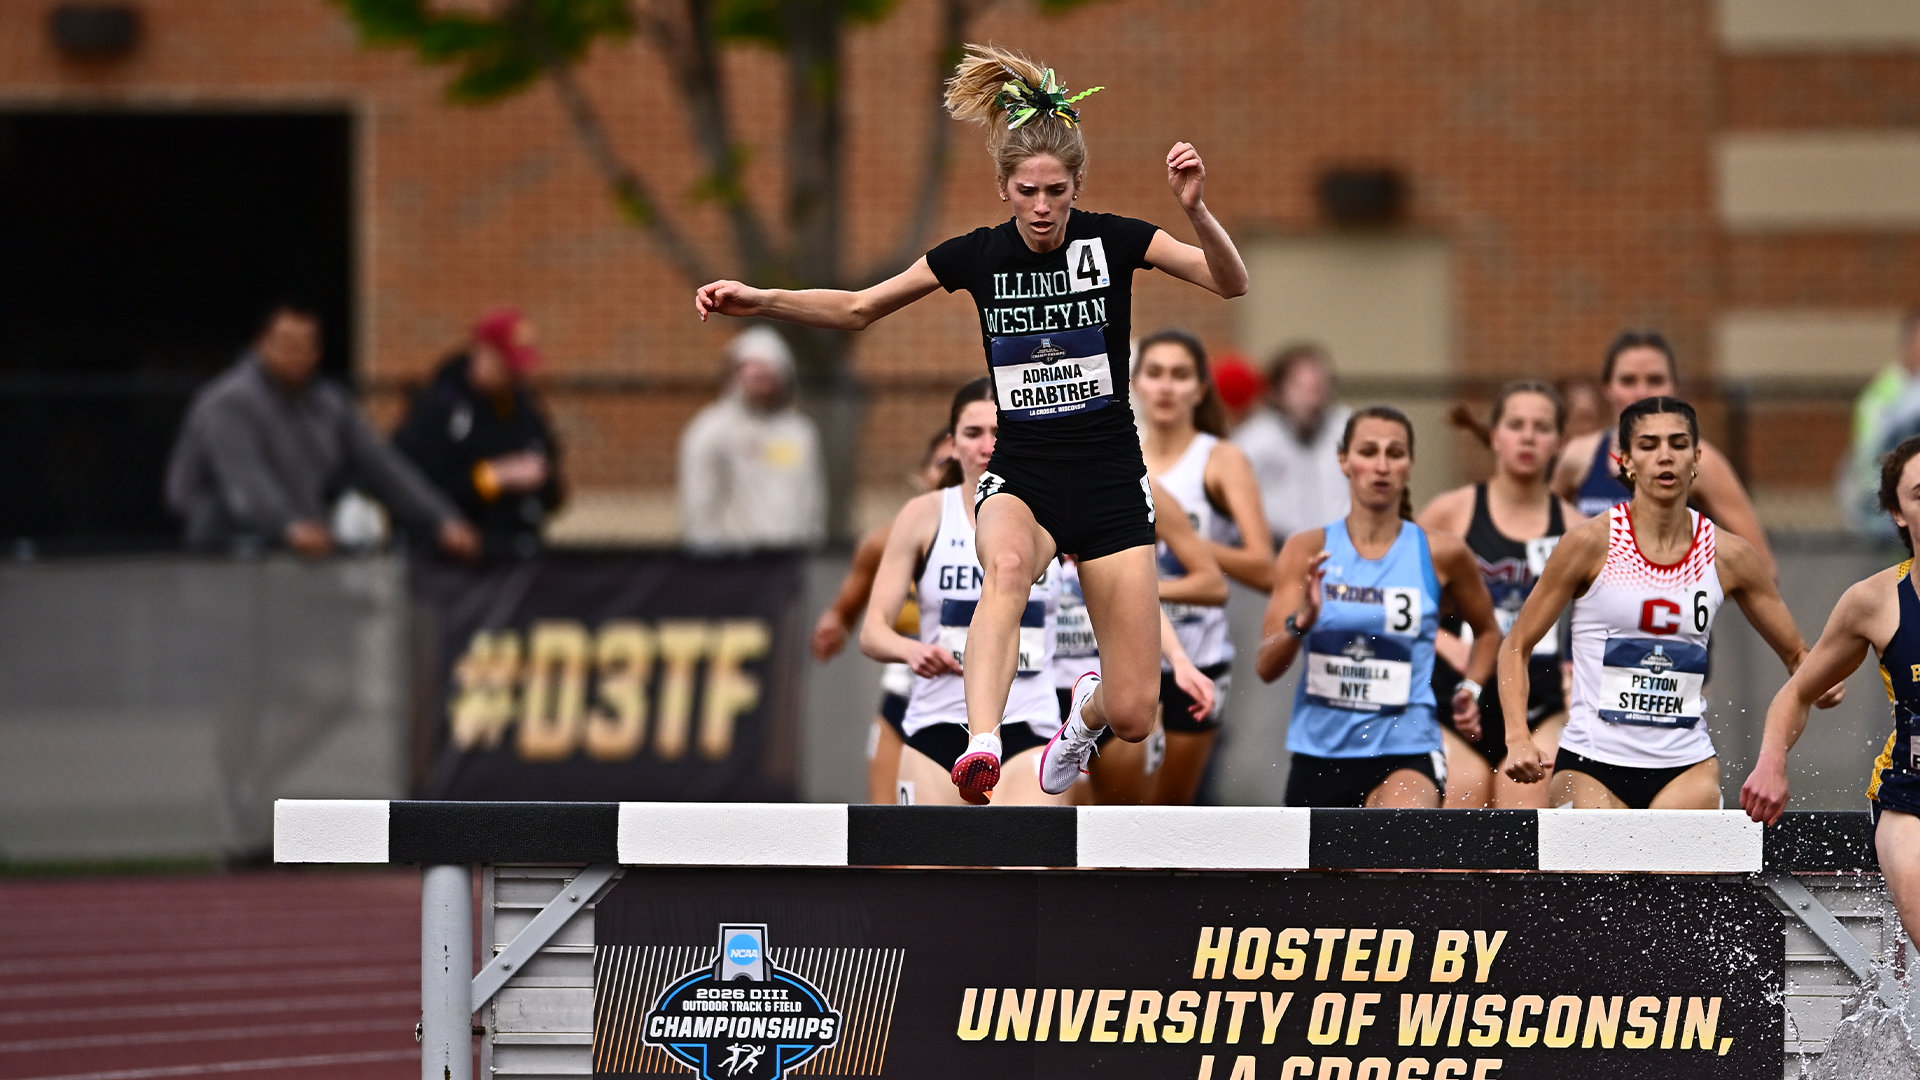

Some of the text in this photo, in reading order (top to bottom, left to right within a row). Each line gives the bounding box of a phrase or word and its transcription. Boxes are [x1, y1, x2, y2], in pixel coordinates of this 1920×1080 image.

[1077, 244, 1101, 286] 4
[984, 297, 1107, 333] WESLEYAN
[1023, 364, 1082, 384] ADRIANA
[1010, 380, 1100, 408] CRABTREE
[1058, 403, 1086, 413] WISCONSIN
[1393, 593, 1412, 631] 3
[1639, 598, 1680, 635] C
[1693, 591, 1709, 632] 6
[449, 618, 772, 760] #D3TF
[1340, 682, 1371, 700] NYE
[1632, 675, 1678, 692] PEYTON
[1619, 692, 1684, 713] STEFFEN
[730, 949, 759, 958] NCAA
[1193, 926, 1508, 983] HOSTED BY
[682, 1001, 802, 1012] OUTDOOR TRACK & FIELD
[696, 989, 788, 1000] 2026 DIII
[650, 1017, 835, 1040] CHAMPIONSHIPS
[957, 988, 1734, 1056] UNIVERSITY OF WISCONSIN,
